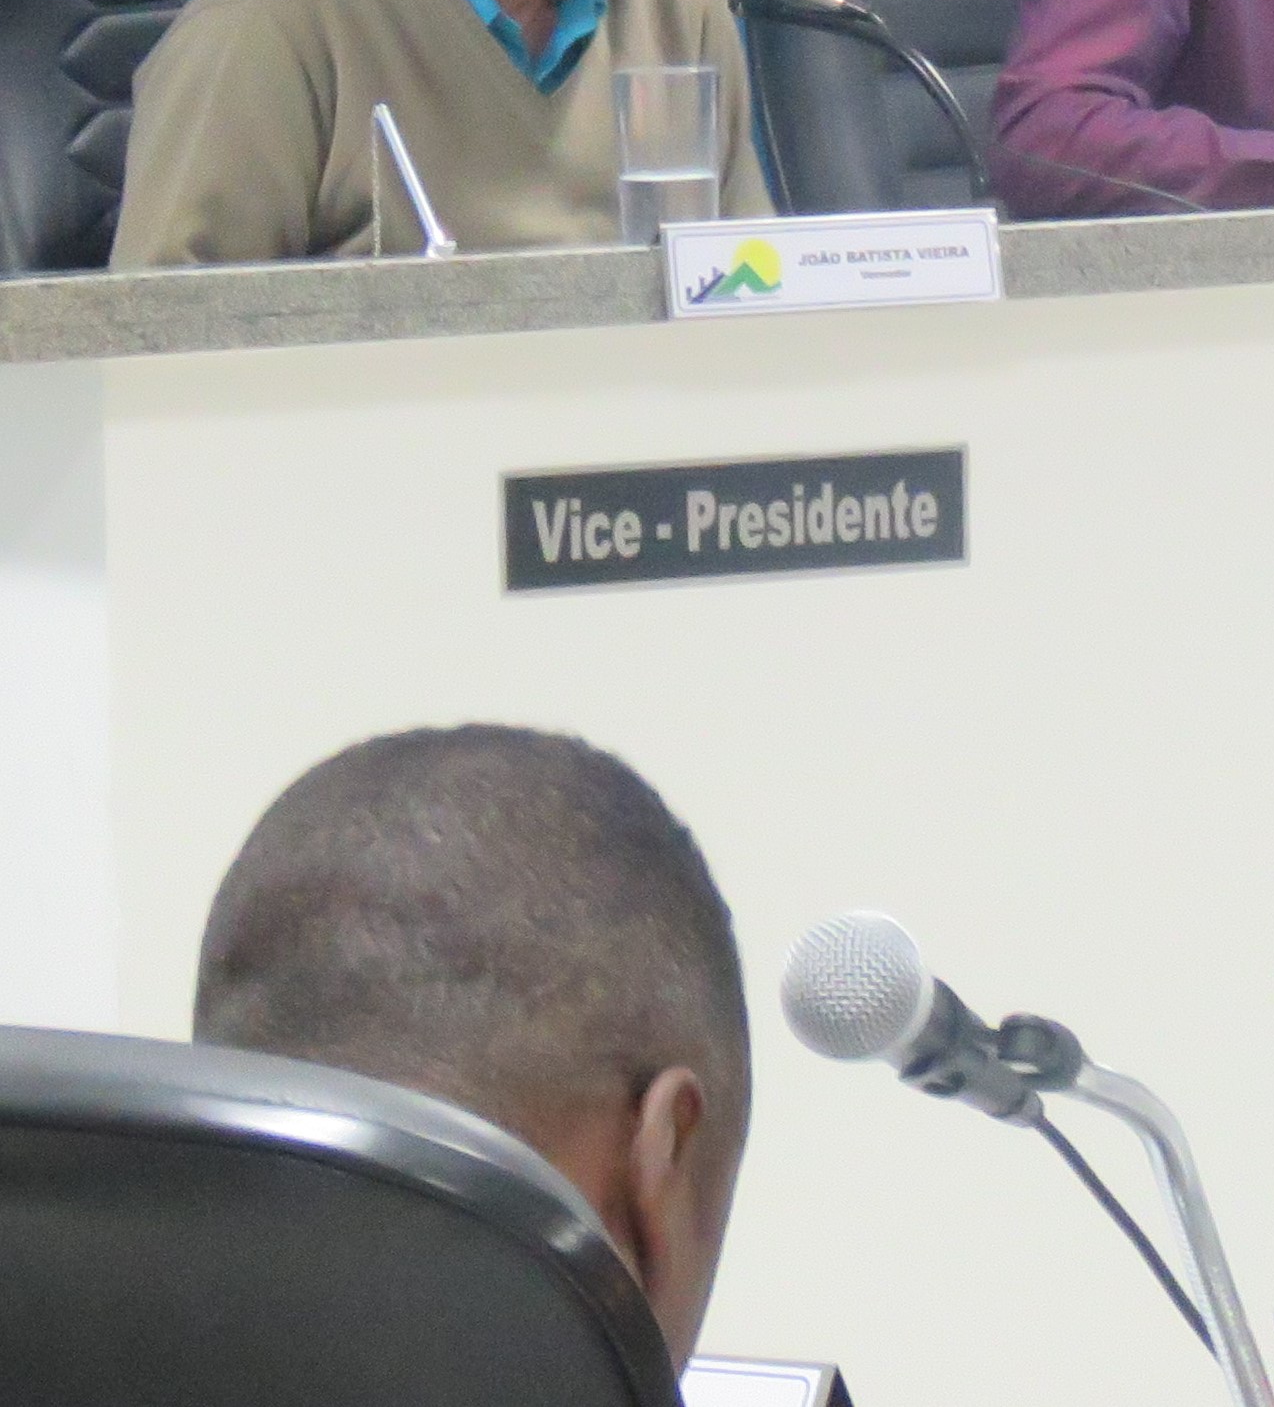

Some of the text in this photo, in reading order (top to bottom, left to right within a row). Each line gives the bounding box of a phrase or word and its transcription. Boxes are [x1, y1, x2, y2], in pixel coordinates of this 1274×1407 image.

[798, 245, 970, 266] JOÃO BATISTA VIEIRA
[532, 479, 938, 564] Vice - Presidente
